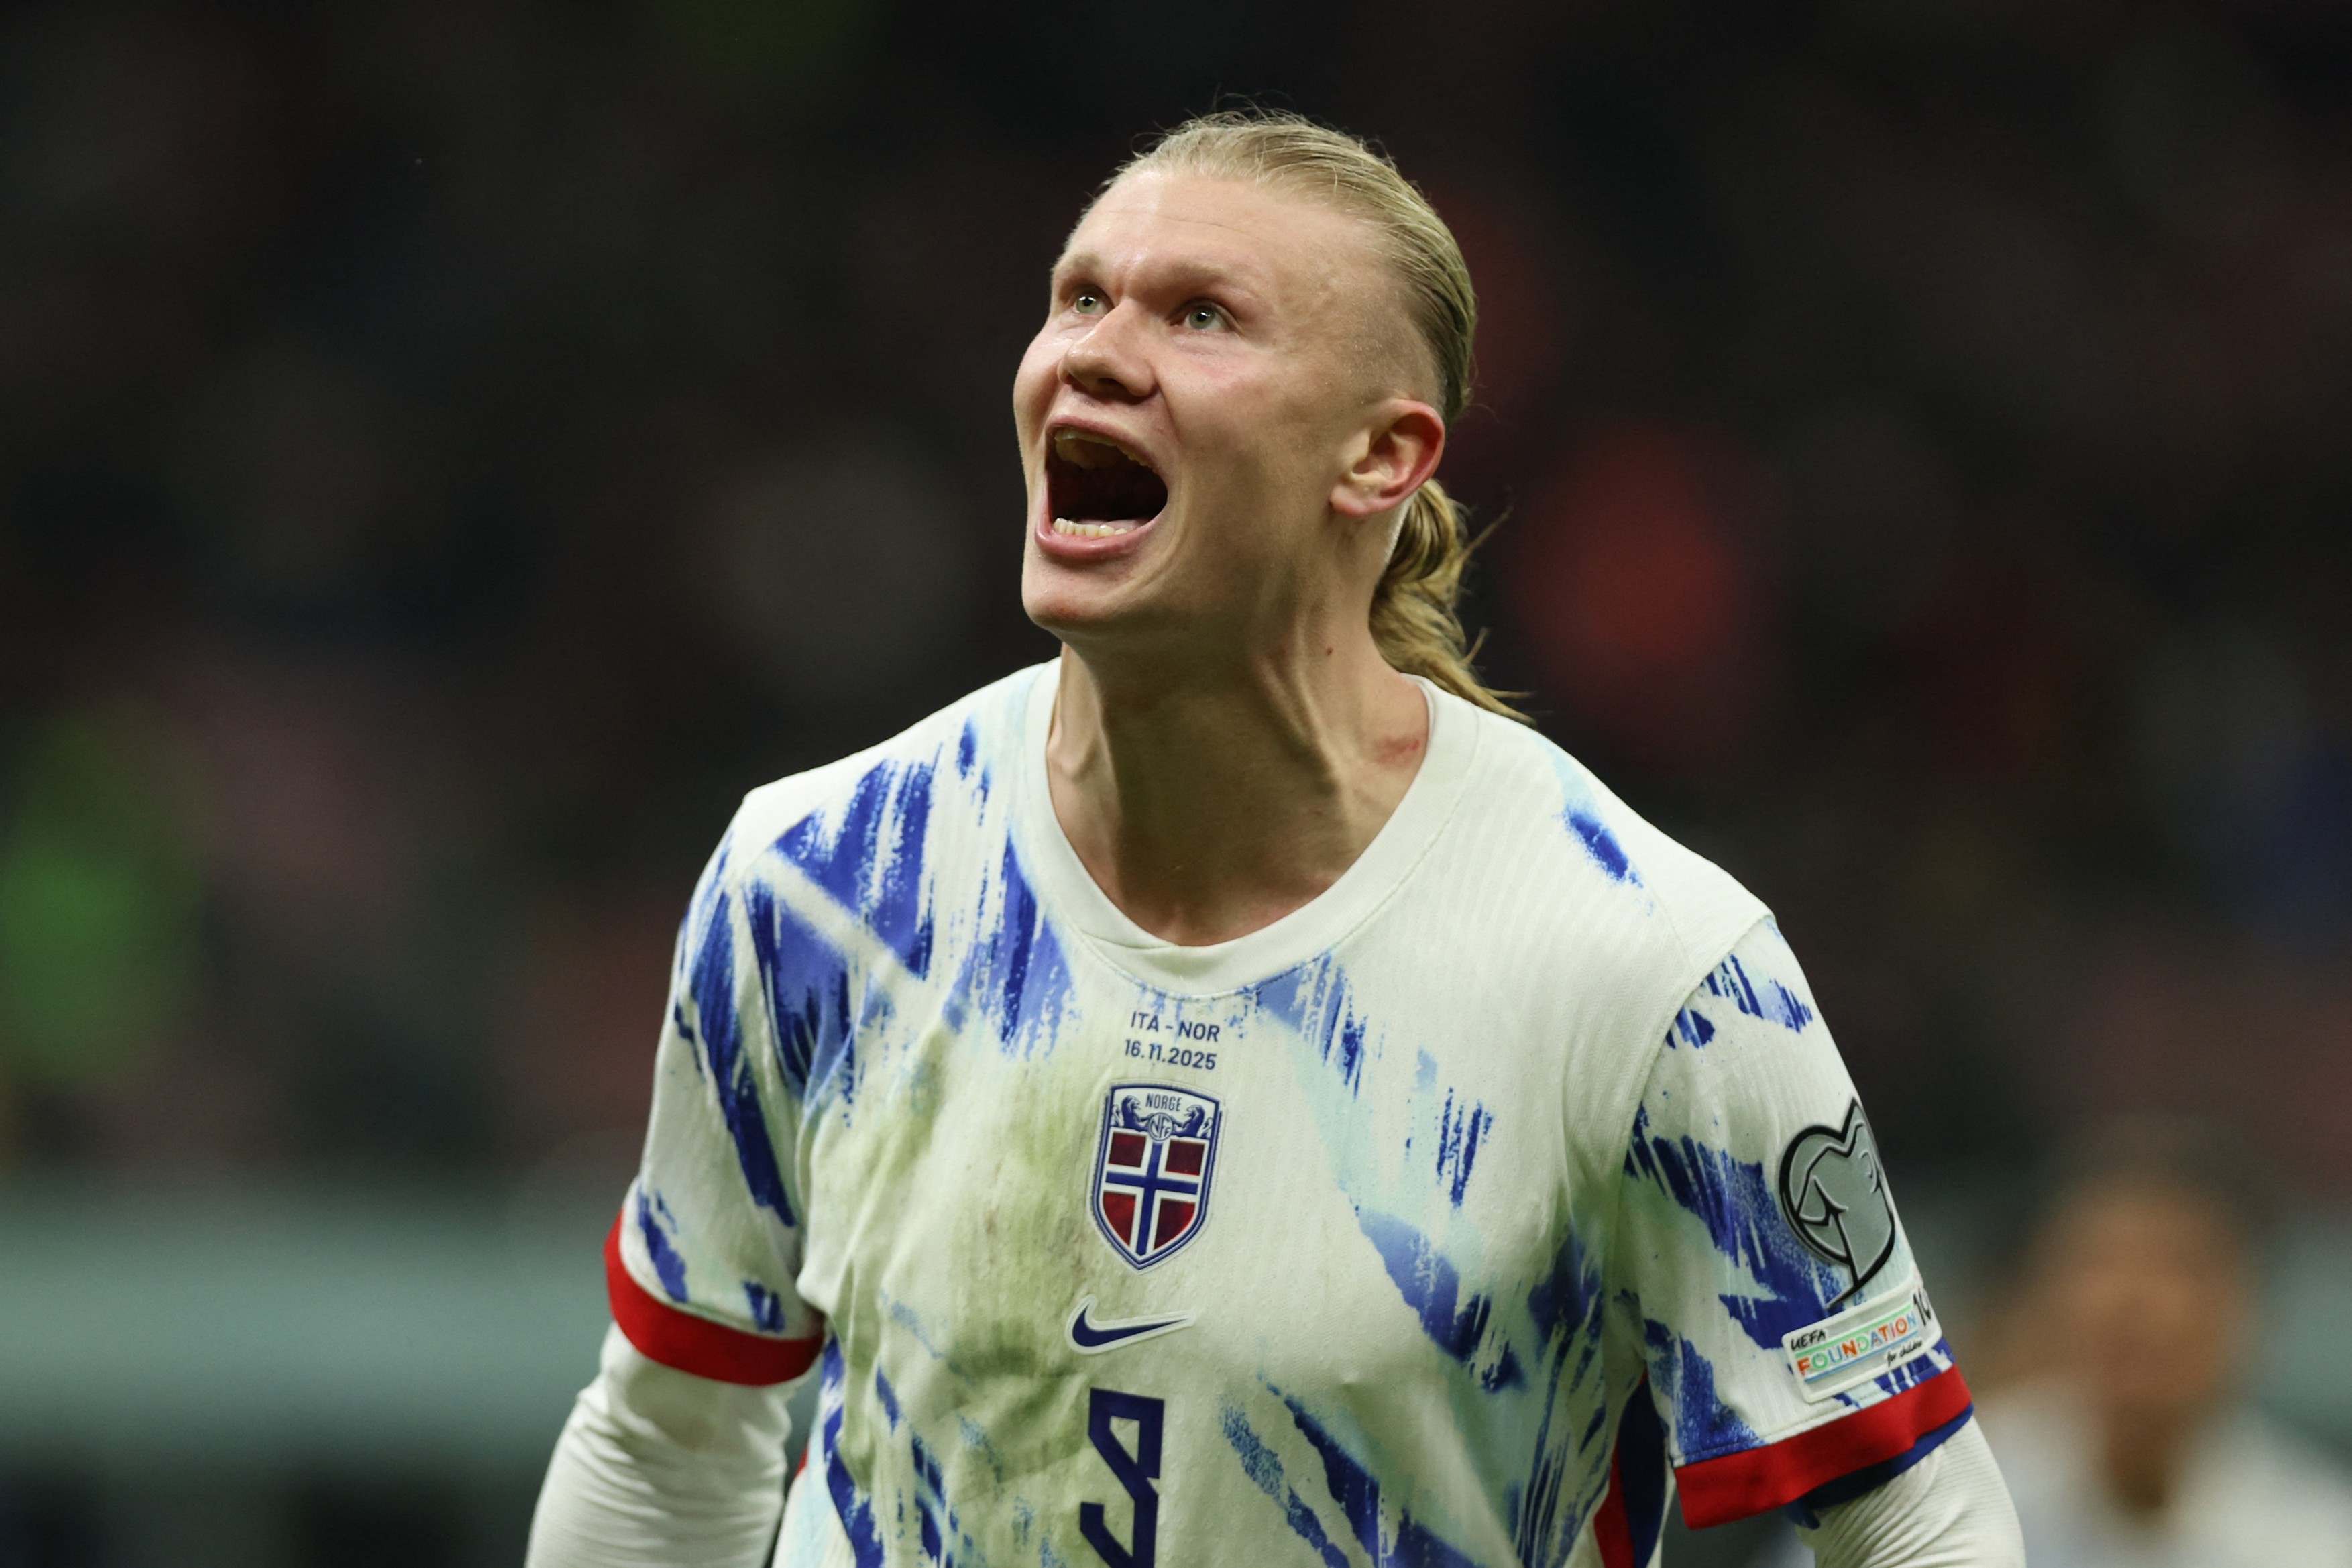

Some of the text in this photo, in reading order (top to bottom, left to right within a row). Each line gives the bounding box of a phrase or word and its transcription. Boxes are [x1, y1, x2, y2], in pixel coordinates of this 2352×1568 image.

[1131, 1011, 1159, 1032] ITA
[1178, 1020, 1220, 1042] NOR
[1125, 1038, 1217, 1070] 16.11.2025
[1145, 1093, 1182, 1112] NORGE
[1791, 1329, 1826, 1351] UEFA
[1797, 1310, 1917, 1376] FOUNDATION
[1080, 1387, 1165, 1568] 9
